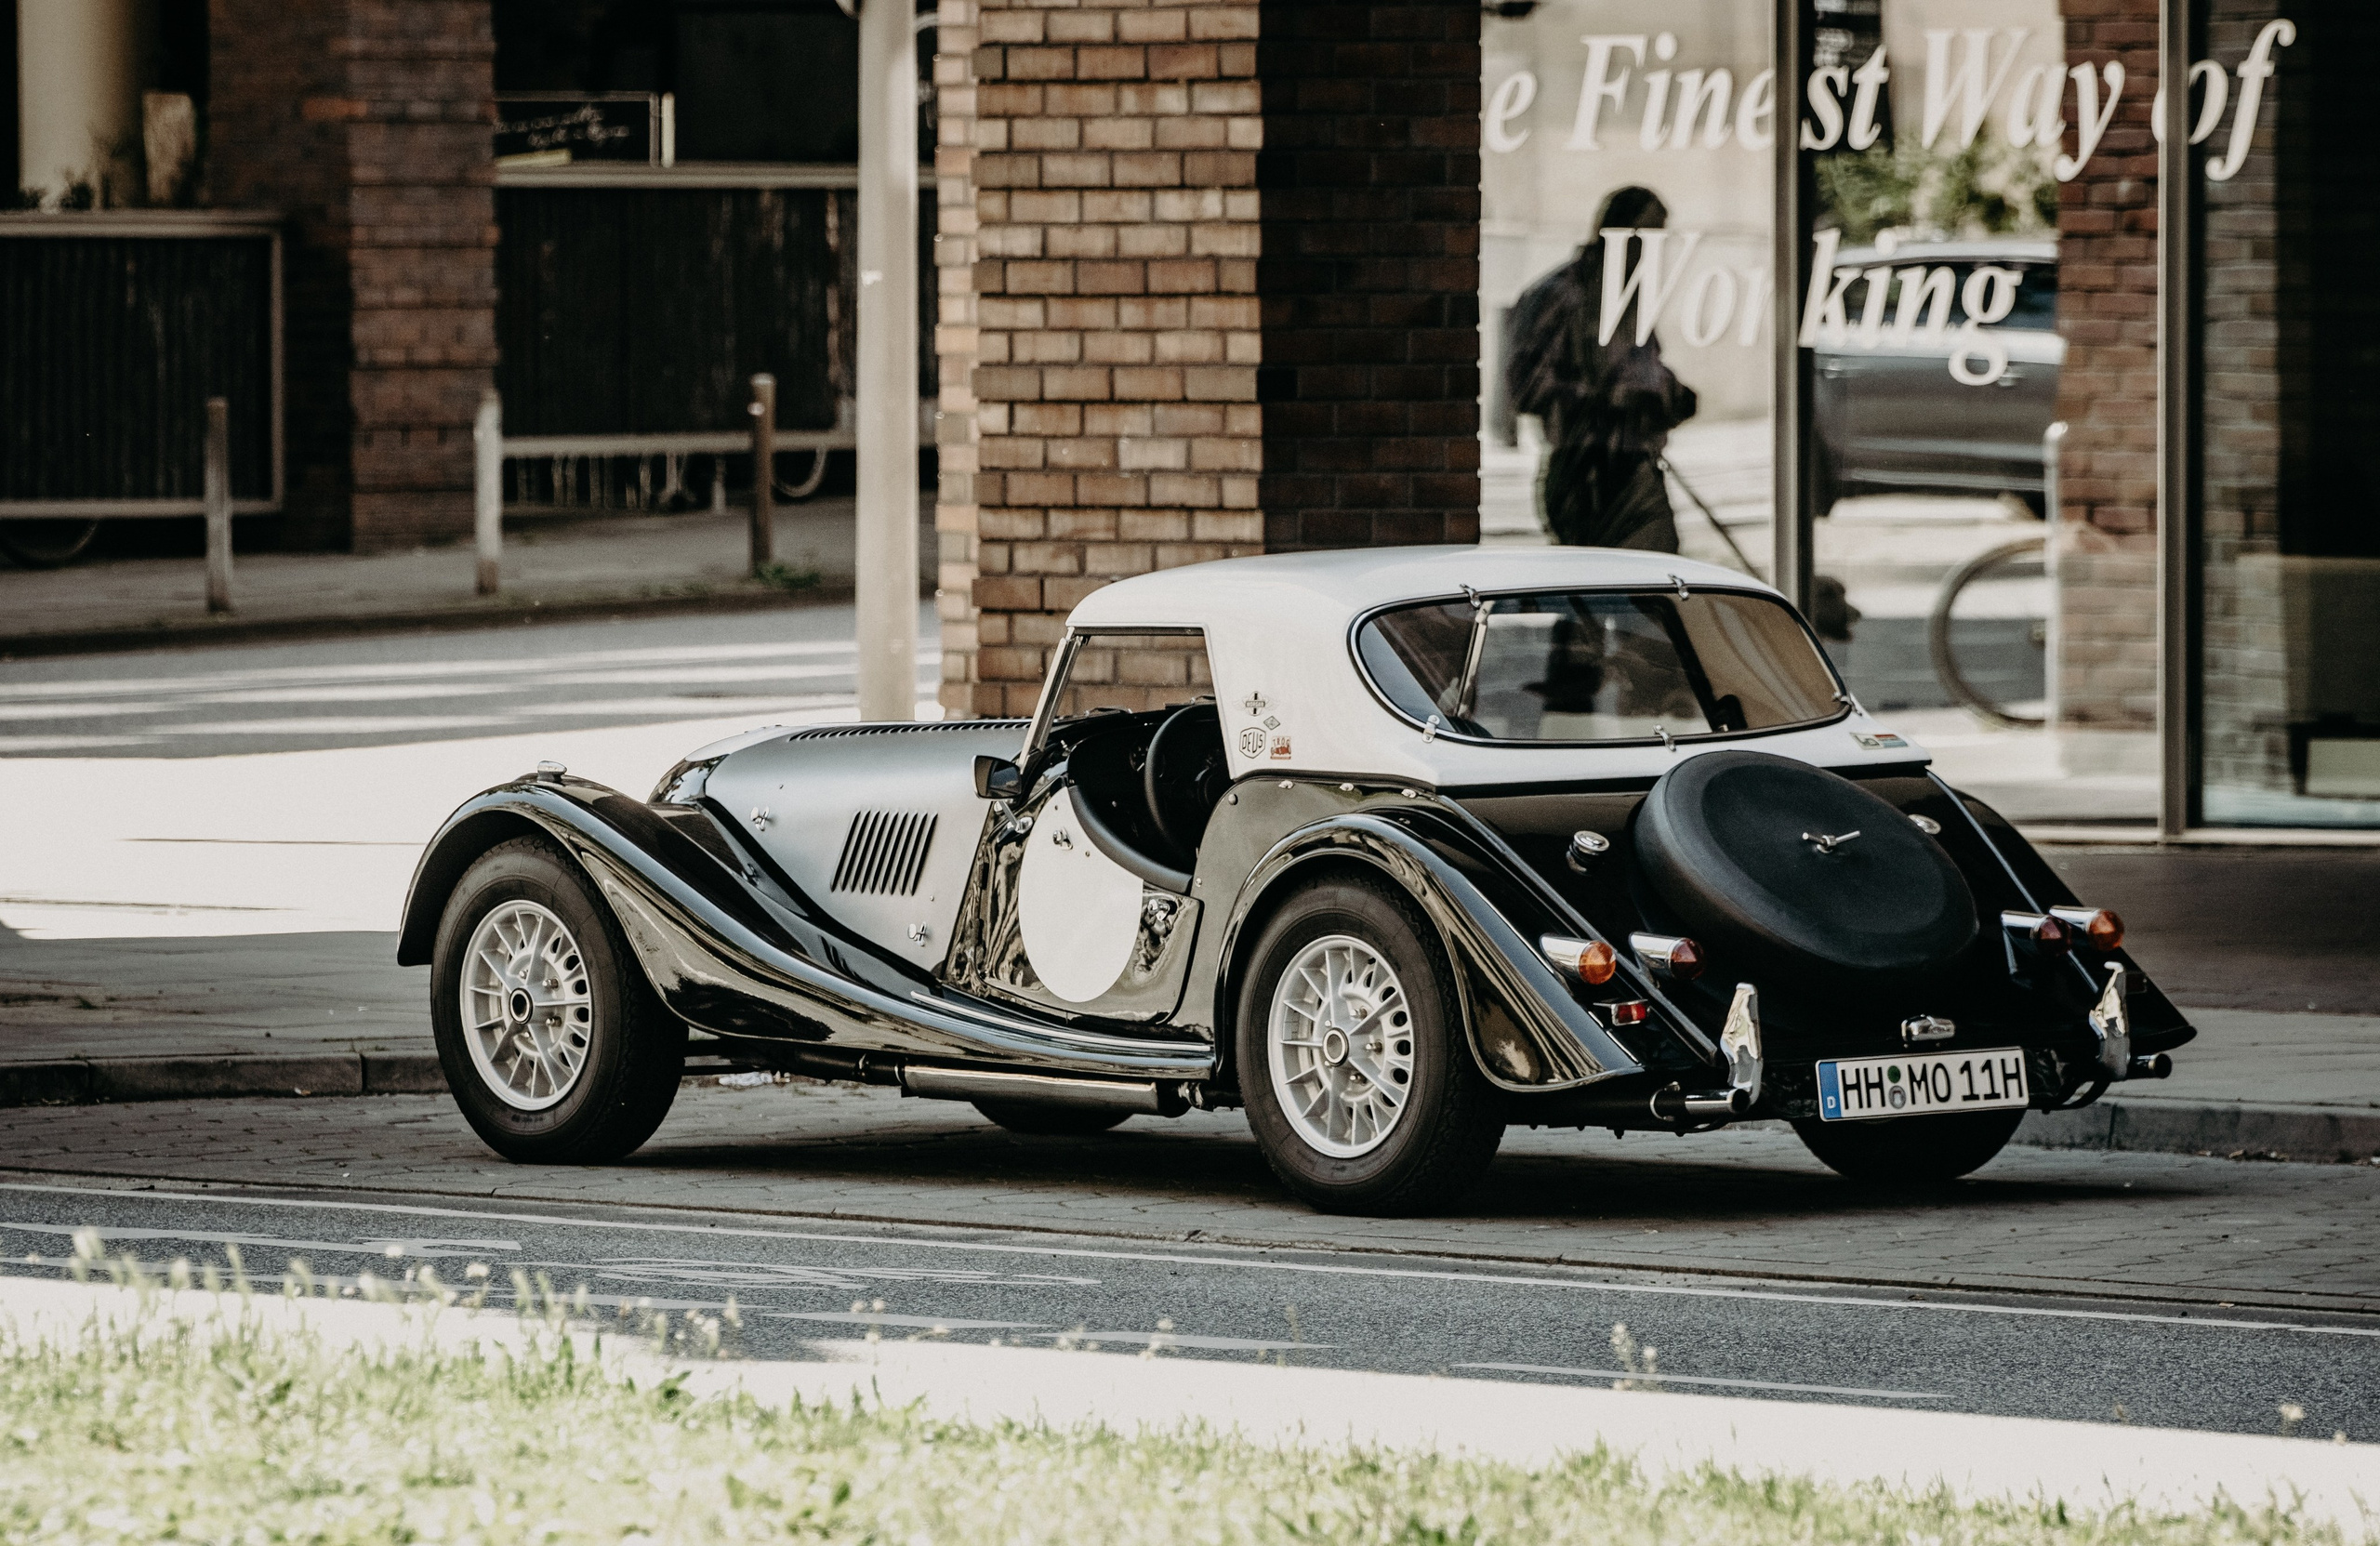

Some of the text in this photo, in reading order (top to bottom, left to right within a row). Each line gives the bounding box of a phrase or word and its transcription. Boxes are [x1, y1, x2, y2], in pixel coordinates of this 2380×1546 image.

[1563, 31, 1889, 152] Finest
[1922, 28, 2126, 182] Way
[2151, 19, 2296, 181] of
[1598, 227, 2024, 386] Working
[1242, 732, 1263, 753] DEUS
[1826, 1096, 1836, 1109] D
[1841, 1057, 2023, 1110] HH MO 11H
